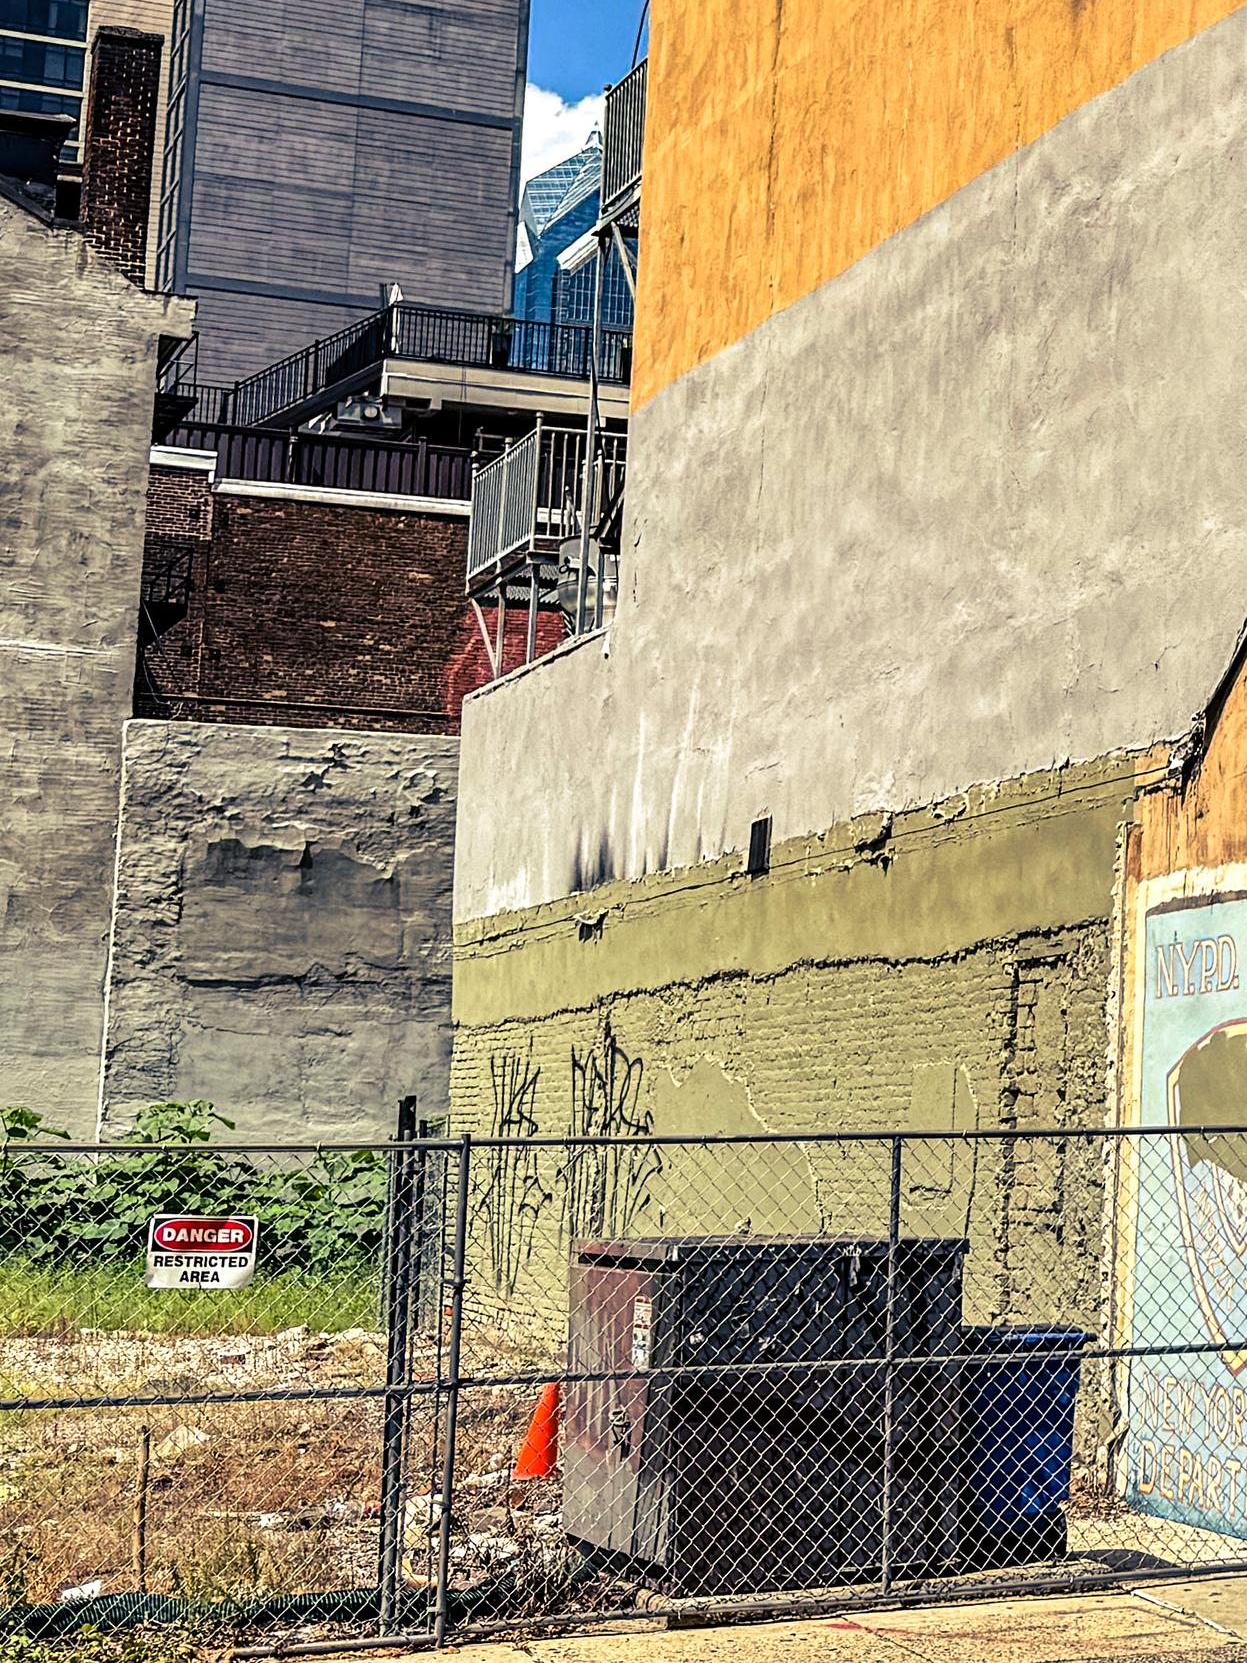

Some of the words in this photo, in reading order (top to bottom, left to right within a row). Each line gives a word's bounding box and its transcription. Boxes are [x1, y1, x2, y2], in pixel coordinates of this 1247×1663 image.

[162, 1227, 244, 1244] DANGER
[153, 1255, 248, 1267] RESTRICTED
[180, 1270, 220, 1283] AREA
[1140, 1371, 1197, 1436] NEW
